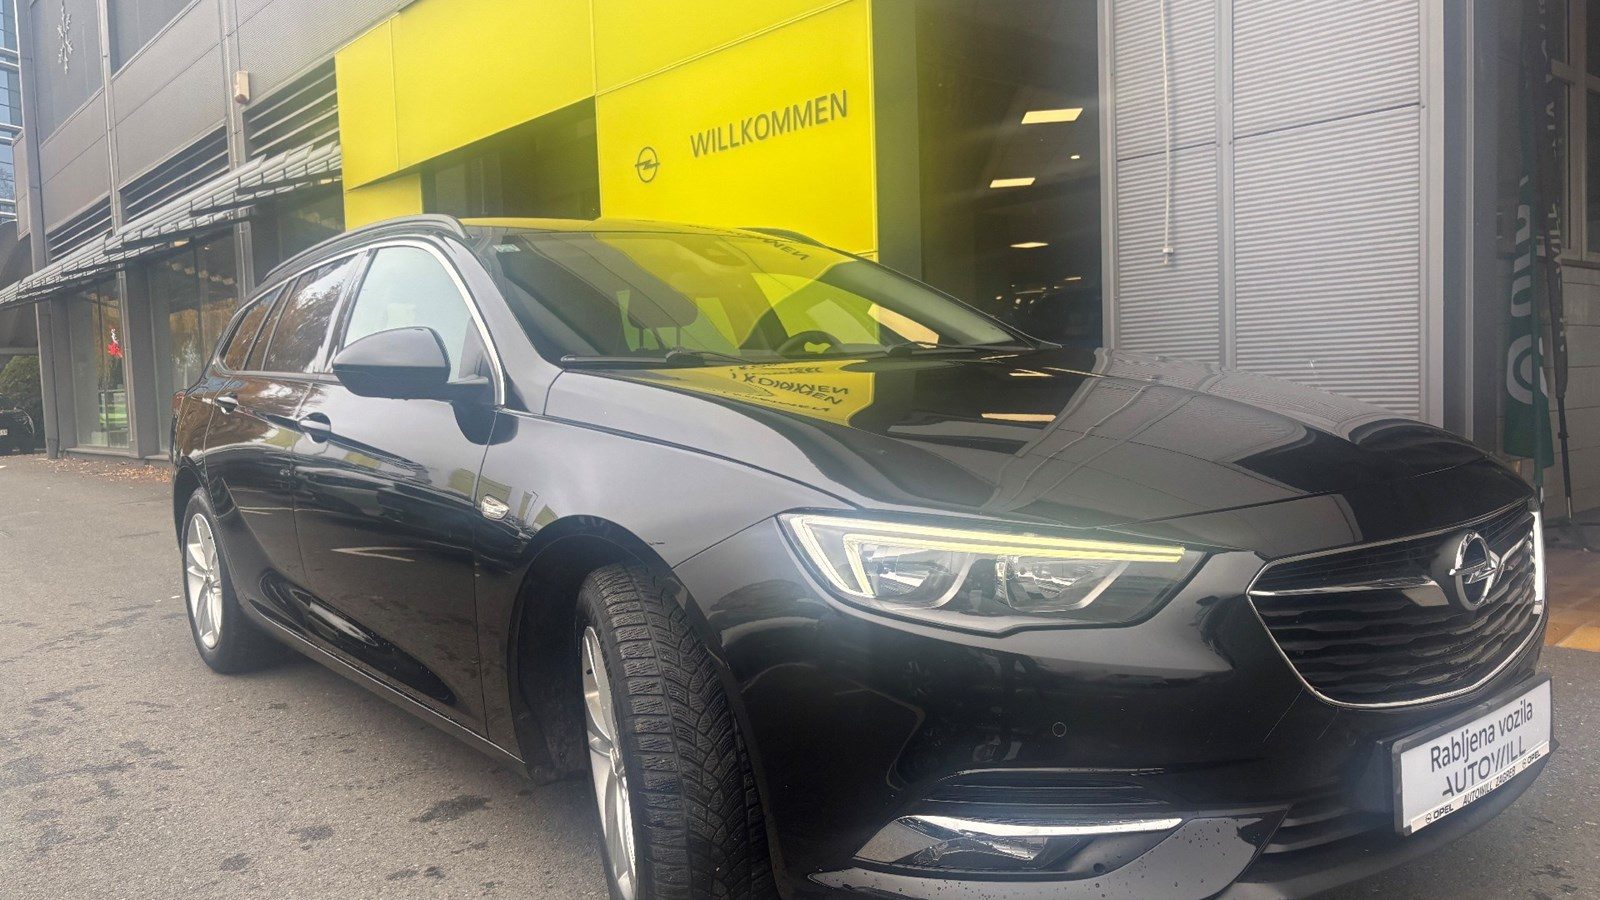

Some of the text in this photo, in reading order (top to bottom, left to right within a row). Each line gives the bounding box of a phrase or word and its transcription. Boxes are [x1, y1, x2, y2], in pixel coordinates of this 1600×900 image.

[690, 89, 848, 158] WILLKOMMEN
[1430, 699, 1533, 773] Rabljena vozila
[1433, 750, 1541, 819] OPEL AUTOWILL ZAGREB OPEL
